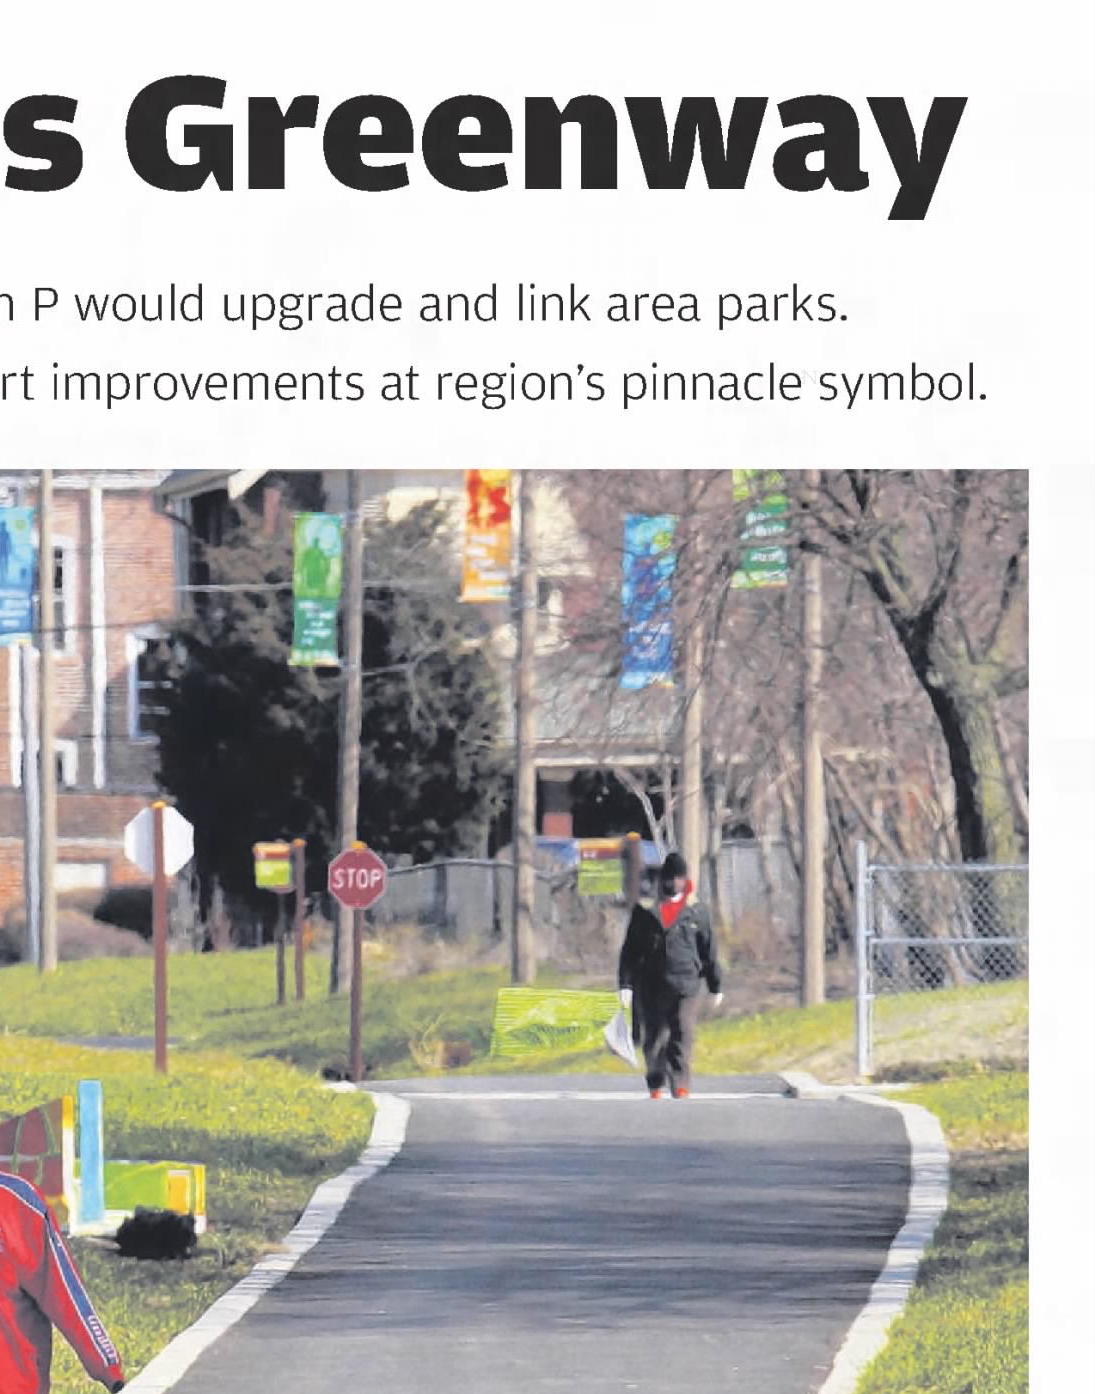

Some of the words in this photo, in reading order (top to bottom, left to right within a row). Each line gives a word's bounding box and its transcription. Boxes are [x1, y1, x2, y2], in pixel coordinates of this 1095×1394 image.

[124, 74, 969, 221] Greenway
[34, 287, 59, 322] P
[74, 282, 203, 322] would
[223, 282, 403, 331] upgrade
[419, 282, 497, 322] and
[518, 282, 592, 322] link
[607, 293, 702, 322] area
[718, 282, 848, 331] parks.
[52, 361, 365, 410] improvements
[381, 365, 420, 401] at
[437, 361, 605, 410] region’s
[623, 361, 802, 410] pinnacle
[819, 361, 987, 410] symbol.
[332, 868, 382, 889] STOP
